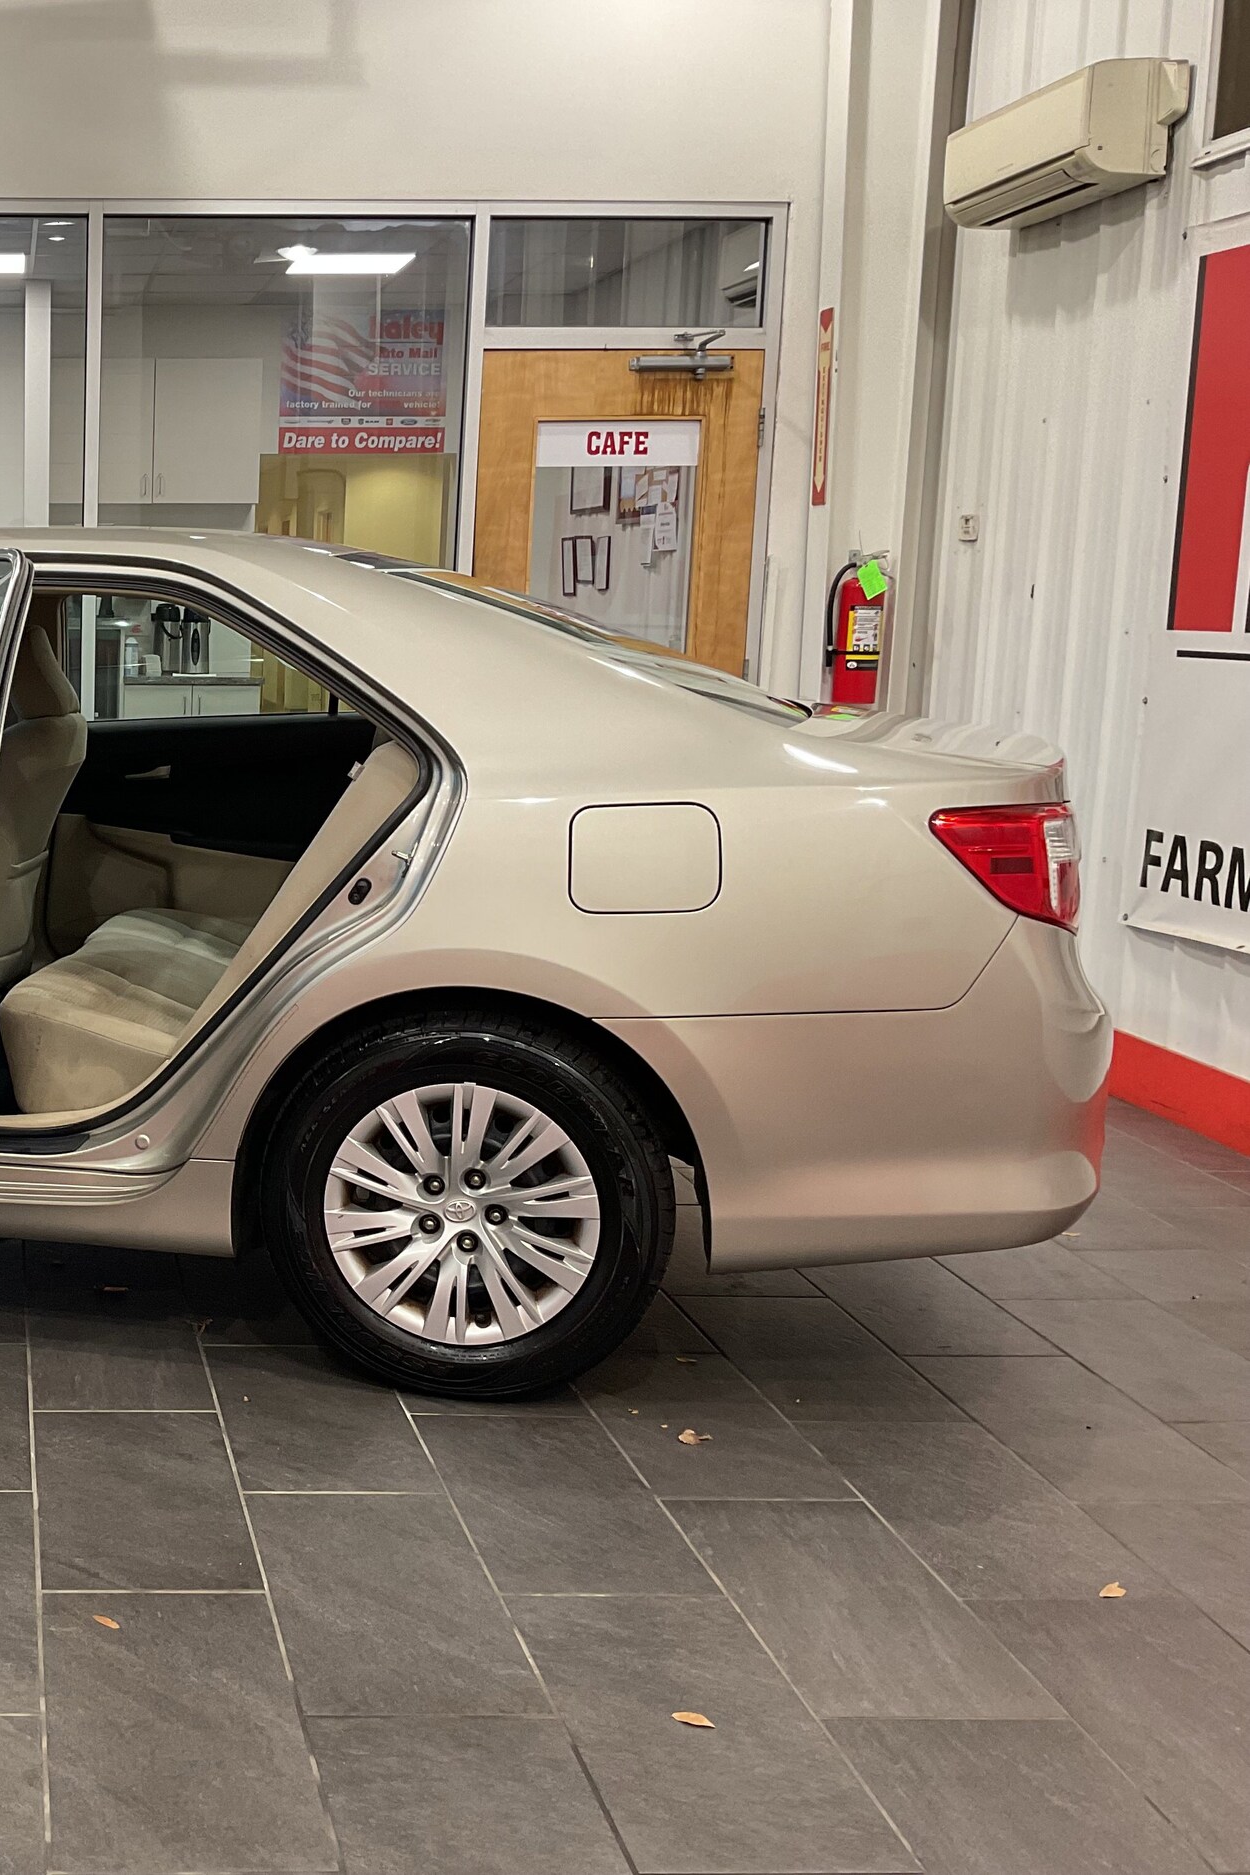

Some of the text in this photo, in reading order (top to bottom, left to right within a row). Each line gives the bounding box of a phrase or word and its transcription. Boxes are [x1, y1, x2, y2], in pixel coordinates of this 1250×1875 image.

[368, 362, 441, 376] SERVICE
[348, 389, 365, 398] Our
[368, 389, 422, 398] technicians
[286, 400, 319, 410] factory
[321, 400, 355, 409] trained
[357, 400, 372, 411] for
[283, 432, 442, 452] Dare to Compare!
[586, 431, 649, 456] CAFE
